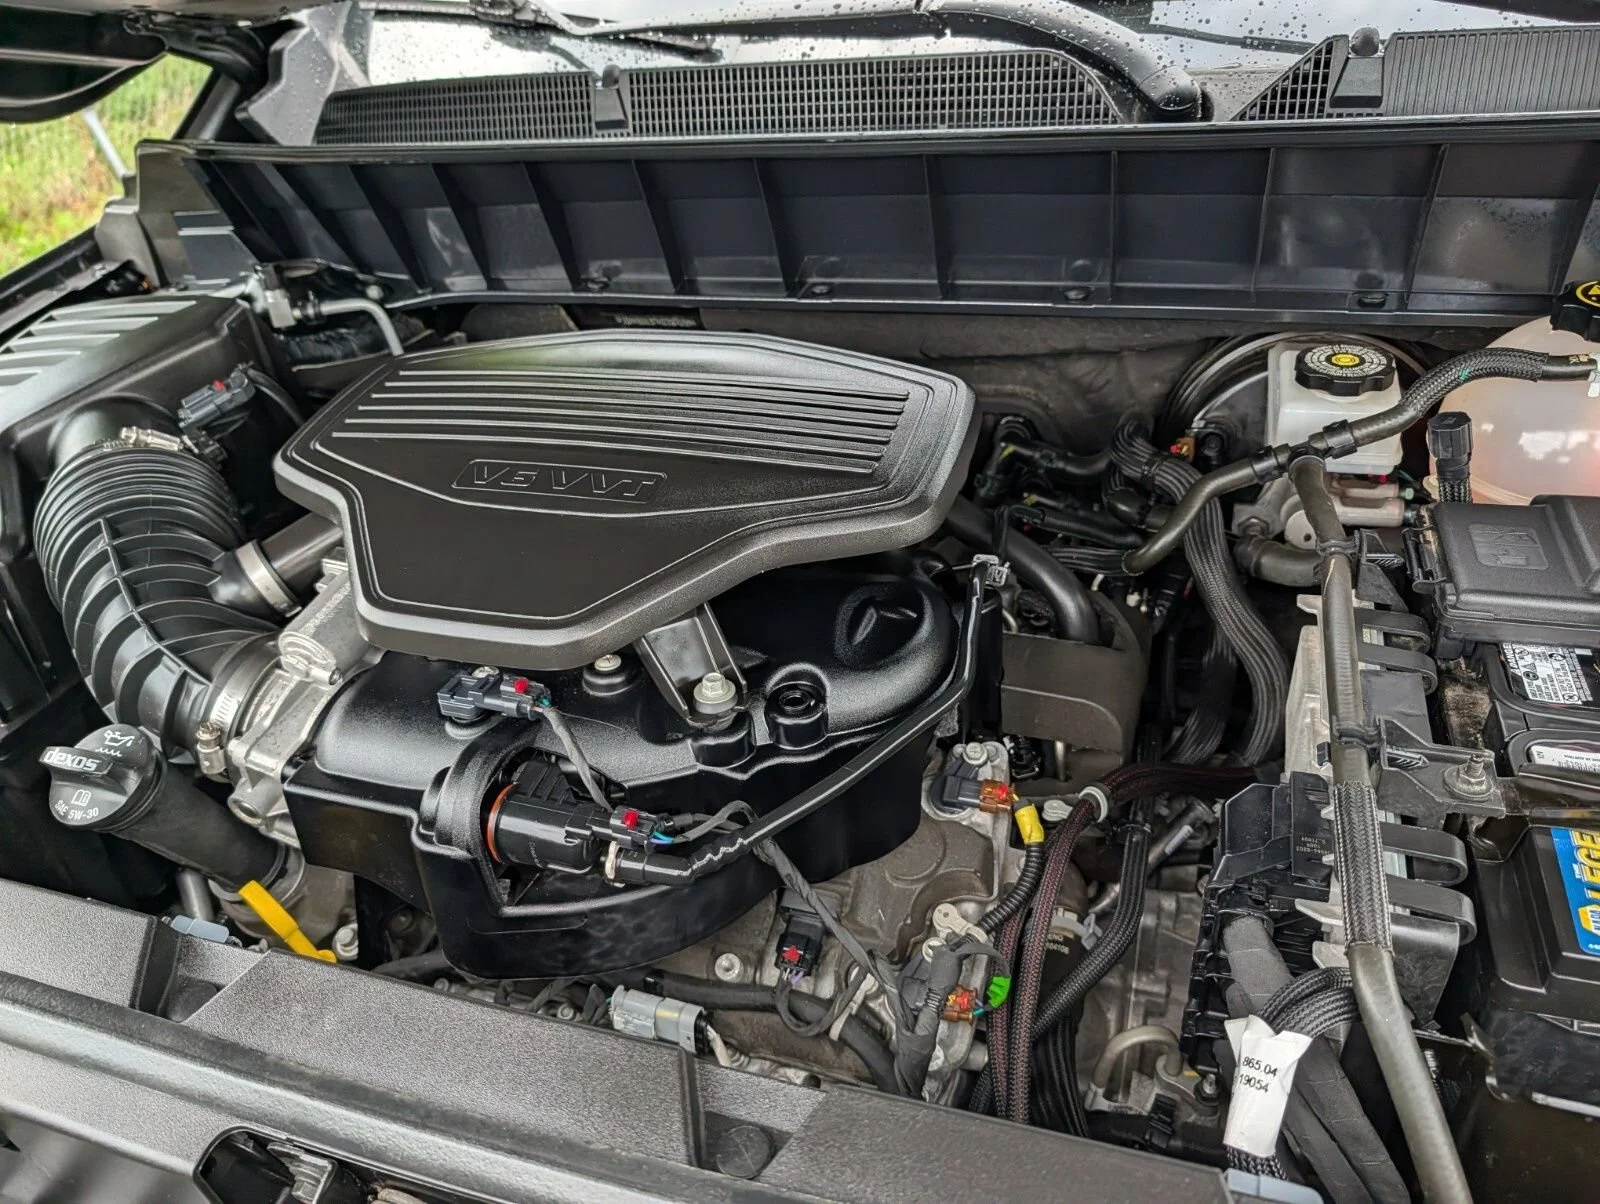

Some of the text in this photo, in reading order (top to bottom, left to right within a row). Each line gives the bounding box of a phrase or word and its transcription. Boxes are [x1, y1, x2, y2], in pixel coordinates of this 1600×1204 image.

[474, 465, 656, 497] V6 VVT
[43, 747, 102, 772] dexos
[54, 799, 99, 820] SAE 5W-30
[1242, 1056, 1278, 1078] 865.04
[1239, 1073, 1269, 1093] 19054
